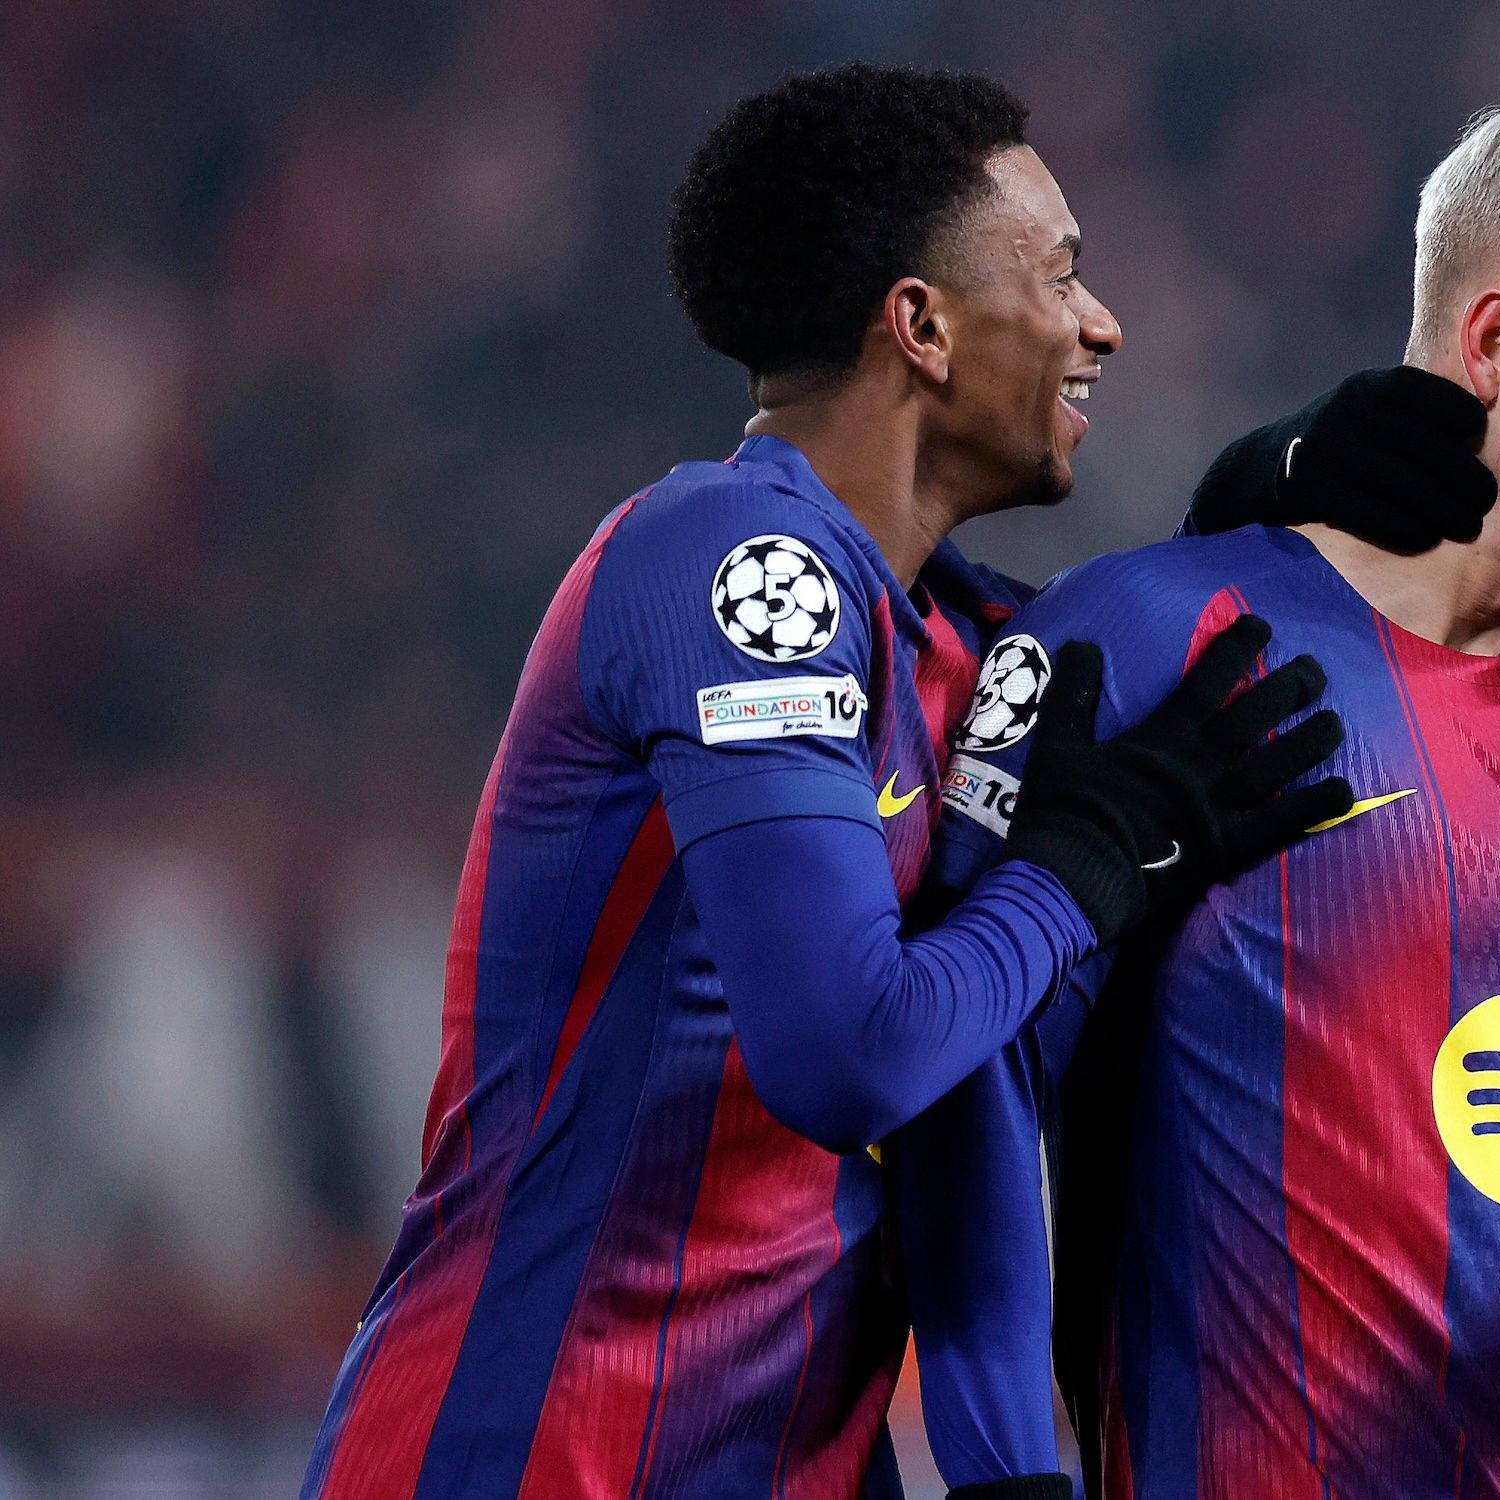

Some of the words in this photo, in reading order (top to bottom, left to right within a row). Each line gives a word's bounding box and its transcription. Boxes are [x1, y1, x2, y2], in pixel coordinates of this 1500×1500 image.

[765, 573, 797, 622] 5
[702, 690, 732, 703] UEFA
[976, 668, 1008, 714] 5
[782, 720, 794, 734] for
